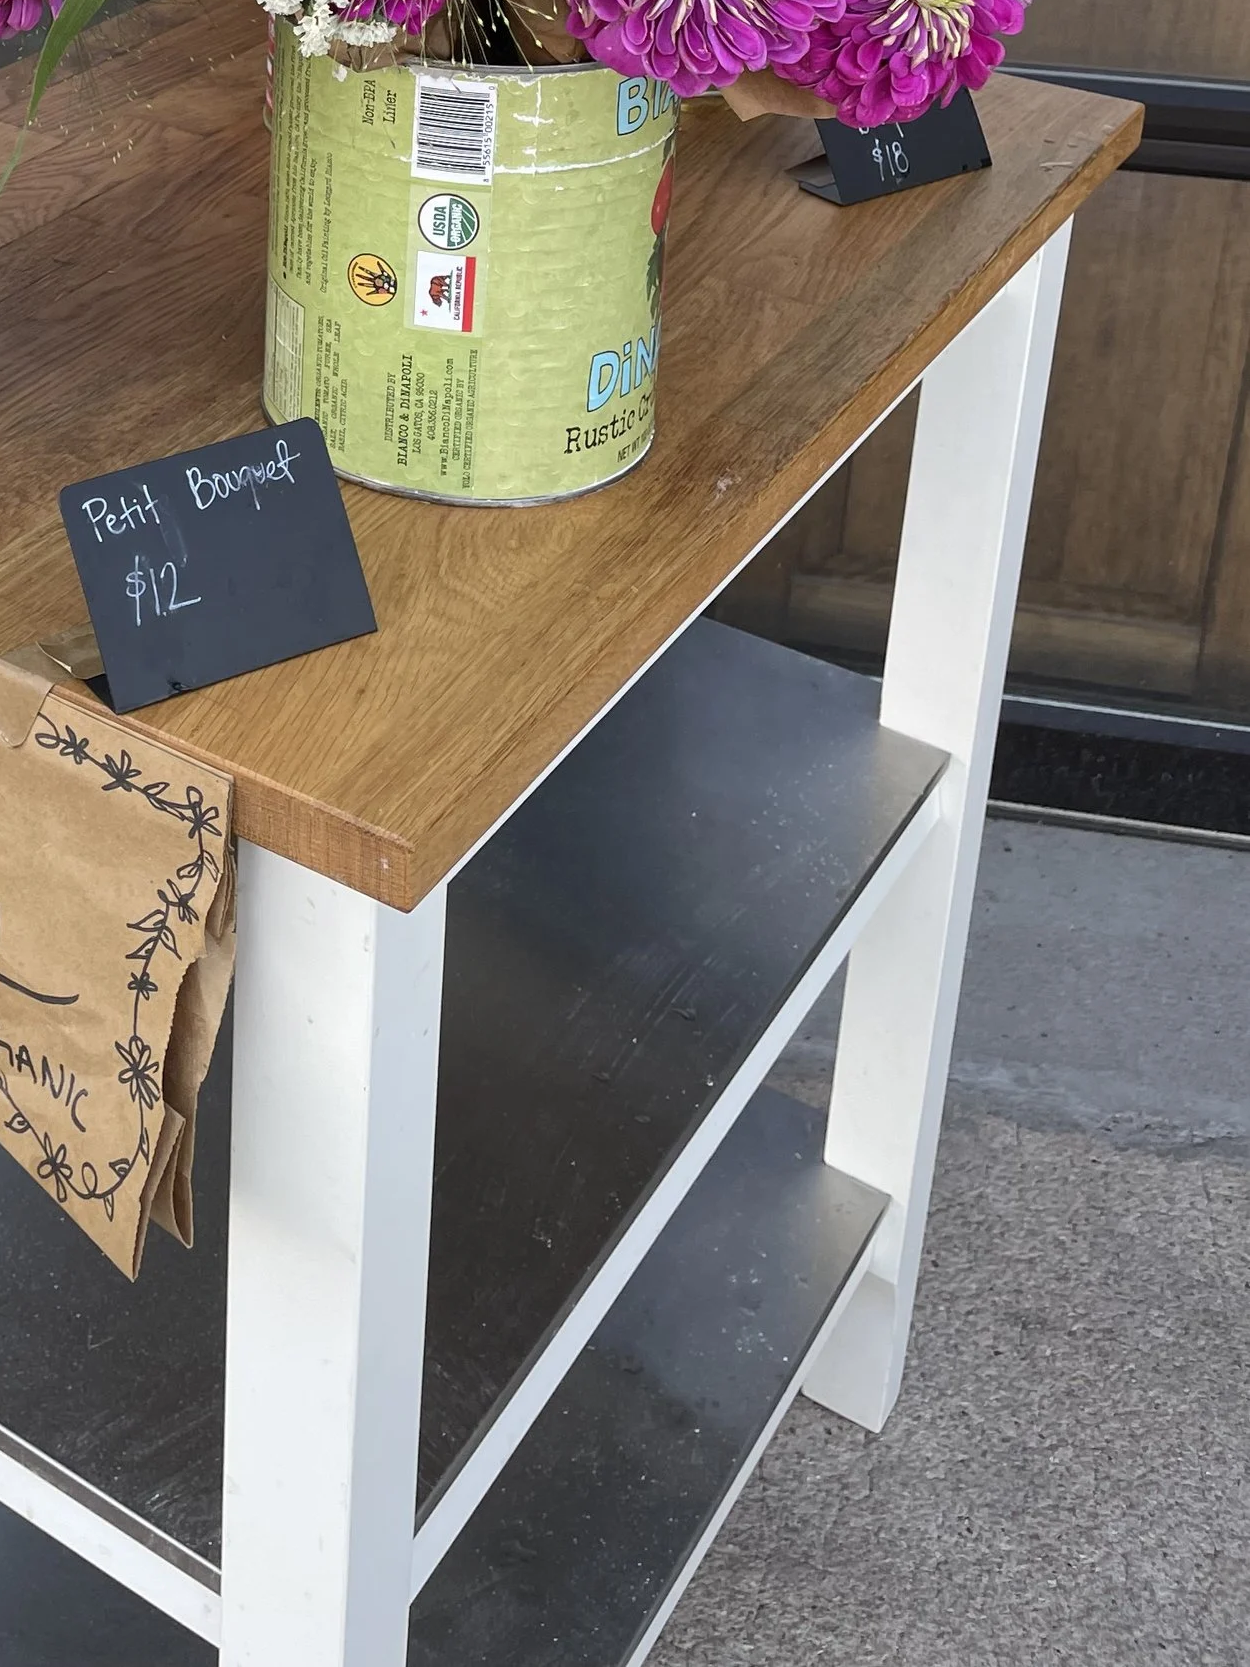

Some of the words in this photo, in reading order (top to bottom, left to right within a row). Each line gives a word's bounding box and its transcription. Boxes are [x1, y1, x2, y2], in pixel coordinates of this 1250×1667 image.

[382, 90, 396, 124] Liner
[484, 104, 493, 133] 00215
[483, 138, 492, 166] 55615
[872, 138, 910, 181] $18
[323, 207, 331, 216] by
[432, 206, 447, 236] USDA
[450, 204, 463, 242] ORGANIC
[322, 218, 331, 249] Painting
[319, 263, 328, 293] Original
[454, 266, 463, 289] REPUBLIC
[453, 292, 461, 320] CALIFORNIA
[333, 321, 341, 343] LEAF
[315, 354, 323, 387] ORGANIC
[387, 372, 396, 384] BY
[400, 354, 412, 410] DiNAPOLI
[456, 378, 465, 388] BY
[468, 349, 478, 398] AGRICULTURE
[331, 386, 339, 419] ORGANIC
[339, 399, 347, 425] CITRIC
[384, 386, 395, 442] DISTRIBUTED
[400, 413, 409, 421] &
[415, 398, 424, 408] CA
[427, 390, 438, 441] 408.356.0212
[439, 358, 454, 476] www.BiancoDiNapoli.com
[454, 390, 464, 420] ORGANIC
[466, 399, 476, 430] ORGANIC
[414, 411, 424, 437] GATOS,
[564, 408, 635, 454] Rustic
[397, 424, 409, 466] BIANCO
[412, 438, 422, 454] LOS
[452, 421, 462, 461] CERTIFIED
[463, 431, 473, 470] CERTIFIED
[617, 444, 631, 463] NET
[82, 484, 160, 543] Petit
[186, 439, 302, 511] Bouquet
[126, 555, 202, 627] $12
